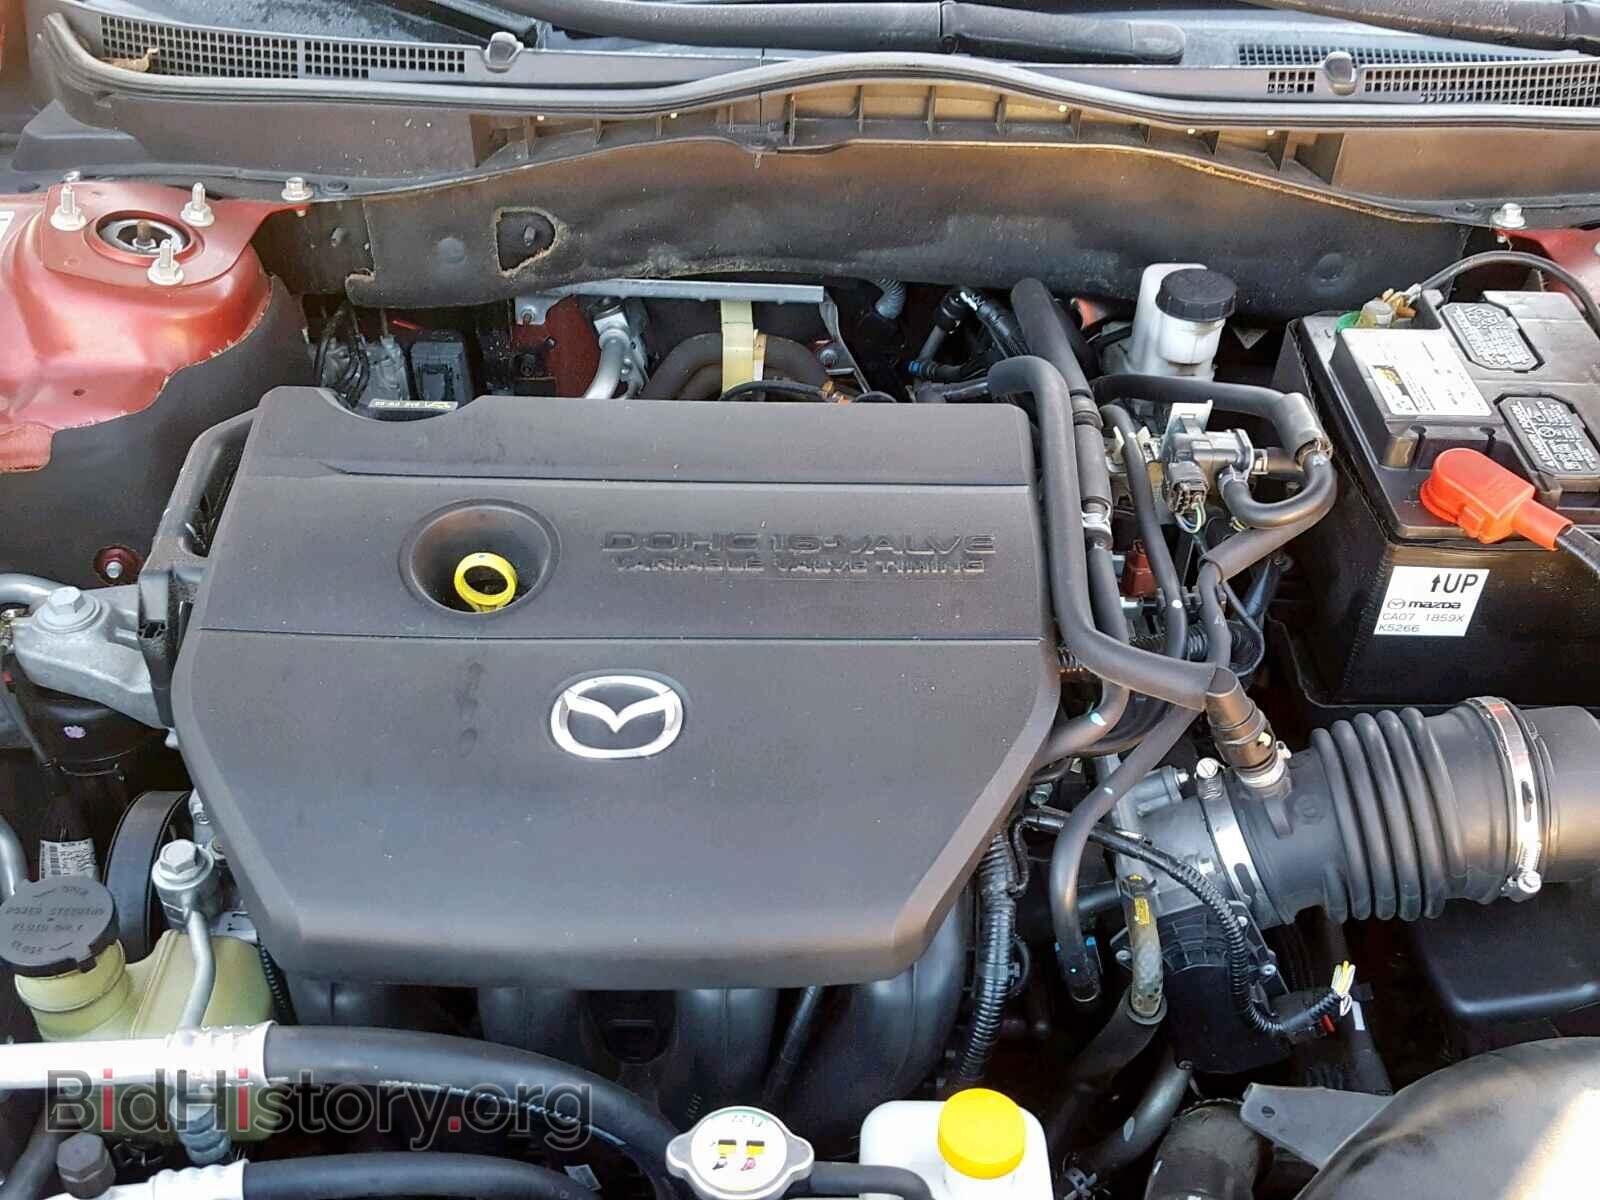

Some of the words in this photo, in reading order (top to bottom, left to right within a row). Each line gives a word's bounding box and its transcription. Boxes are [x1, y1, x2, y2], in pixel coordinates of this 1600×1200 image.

[601, 531, 762, 553] DOHC
[769, 533, 997, 555] 16-VALVE
[773, 558, 868, 574] VALVE
[875, 558, 985, 574] TIMING
[1443, 573, 1479, 593] UP
[1382, 613, 1416, 621] CA07
[1425, 613, 1466, 623] 1859X
